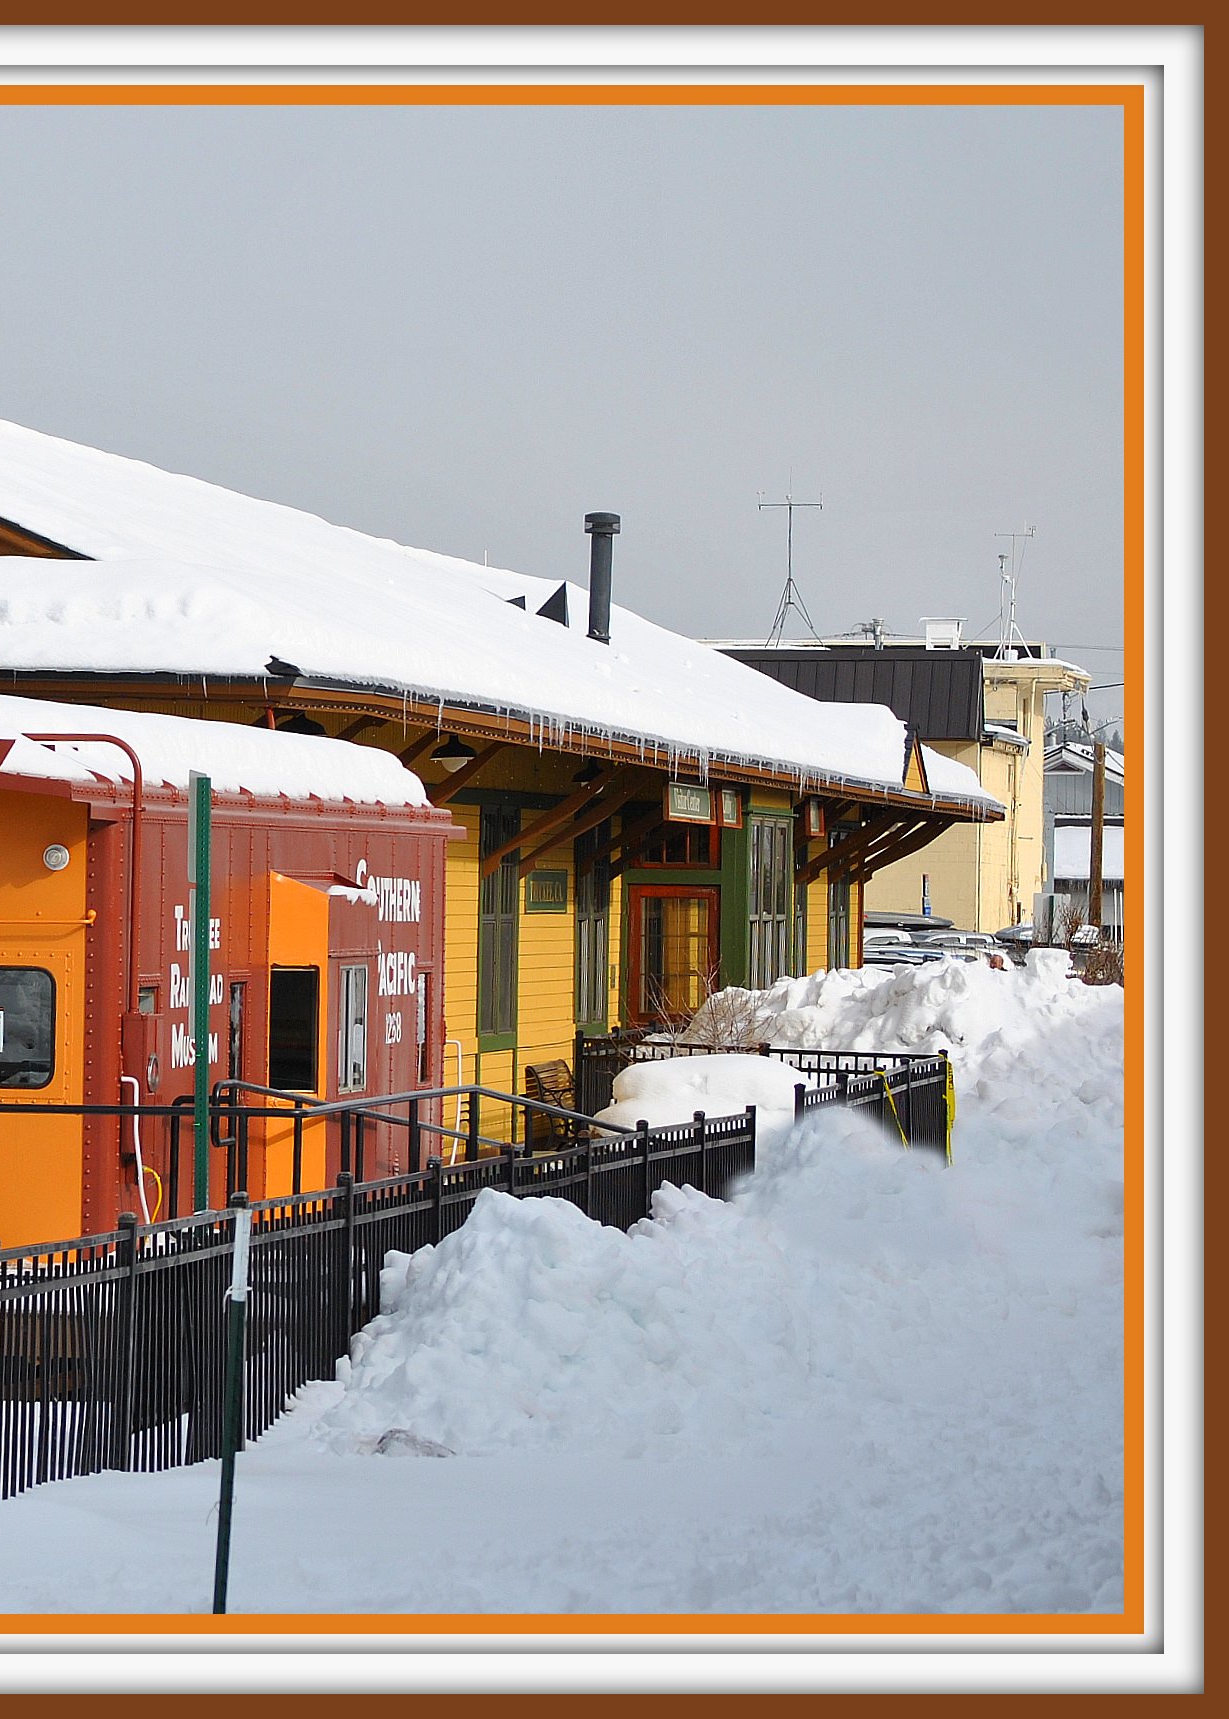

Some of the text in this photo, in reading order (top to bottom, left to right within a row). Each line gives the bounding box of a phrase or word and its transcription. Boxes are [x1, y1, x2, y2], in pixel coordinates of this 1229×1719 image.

[174, 905, 221, 952] TREE
[169, 963, 223, 1009] RAIAD
[377, 939, 416, 997] ACIFIC
[171, 1022, 219, 1069] MUSM
